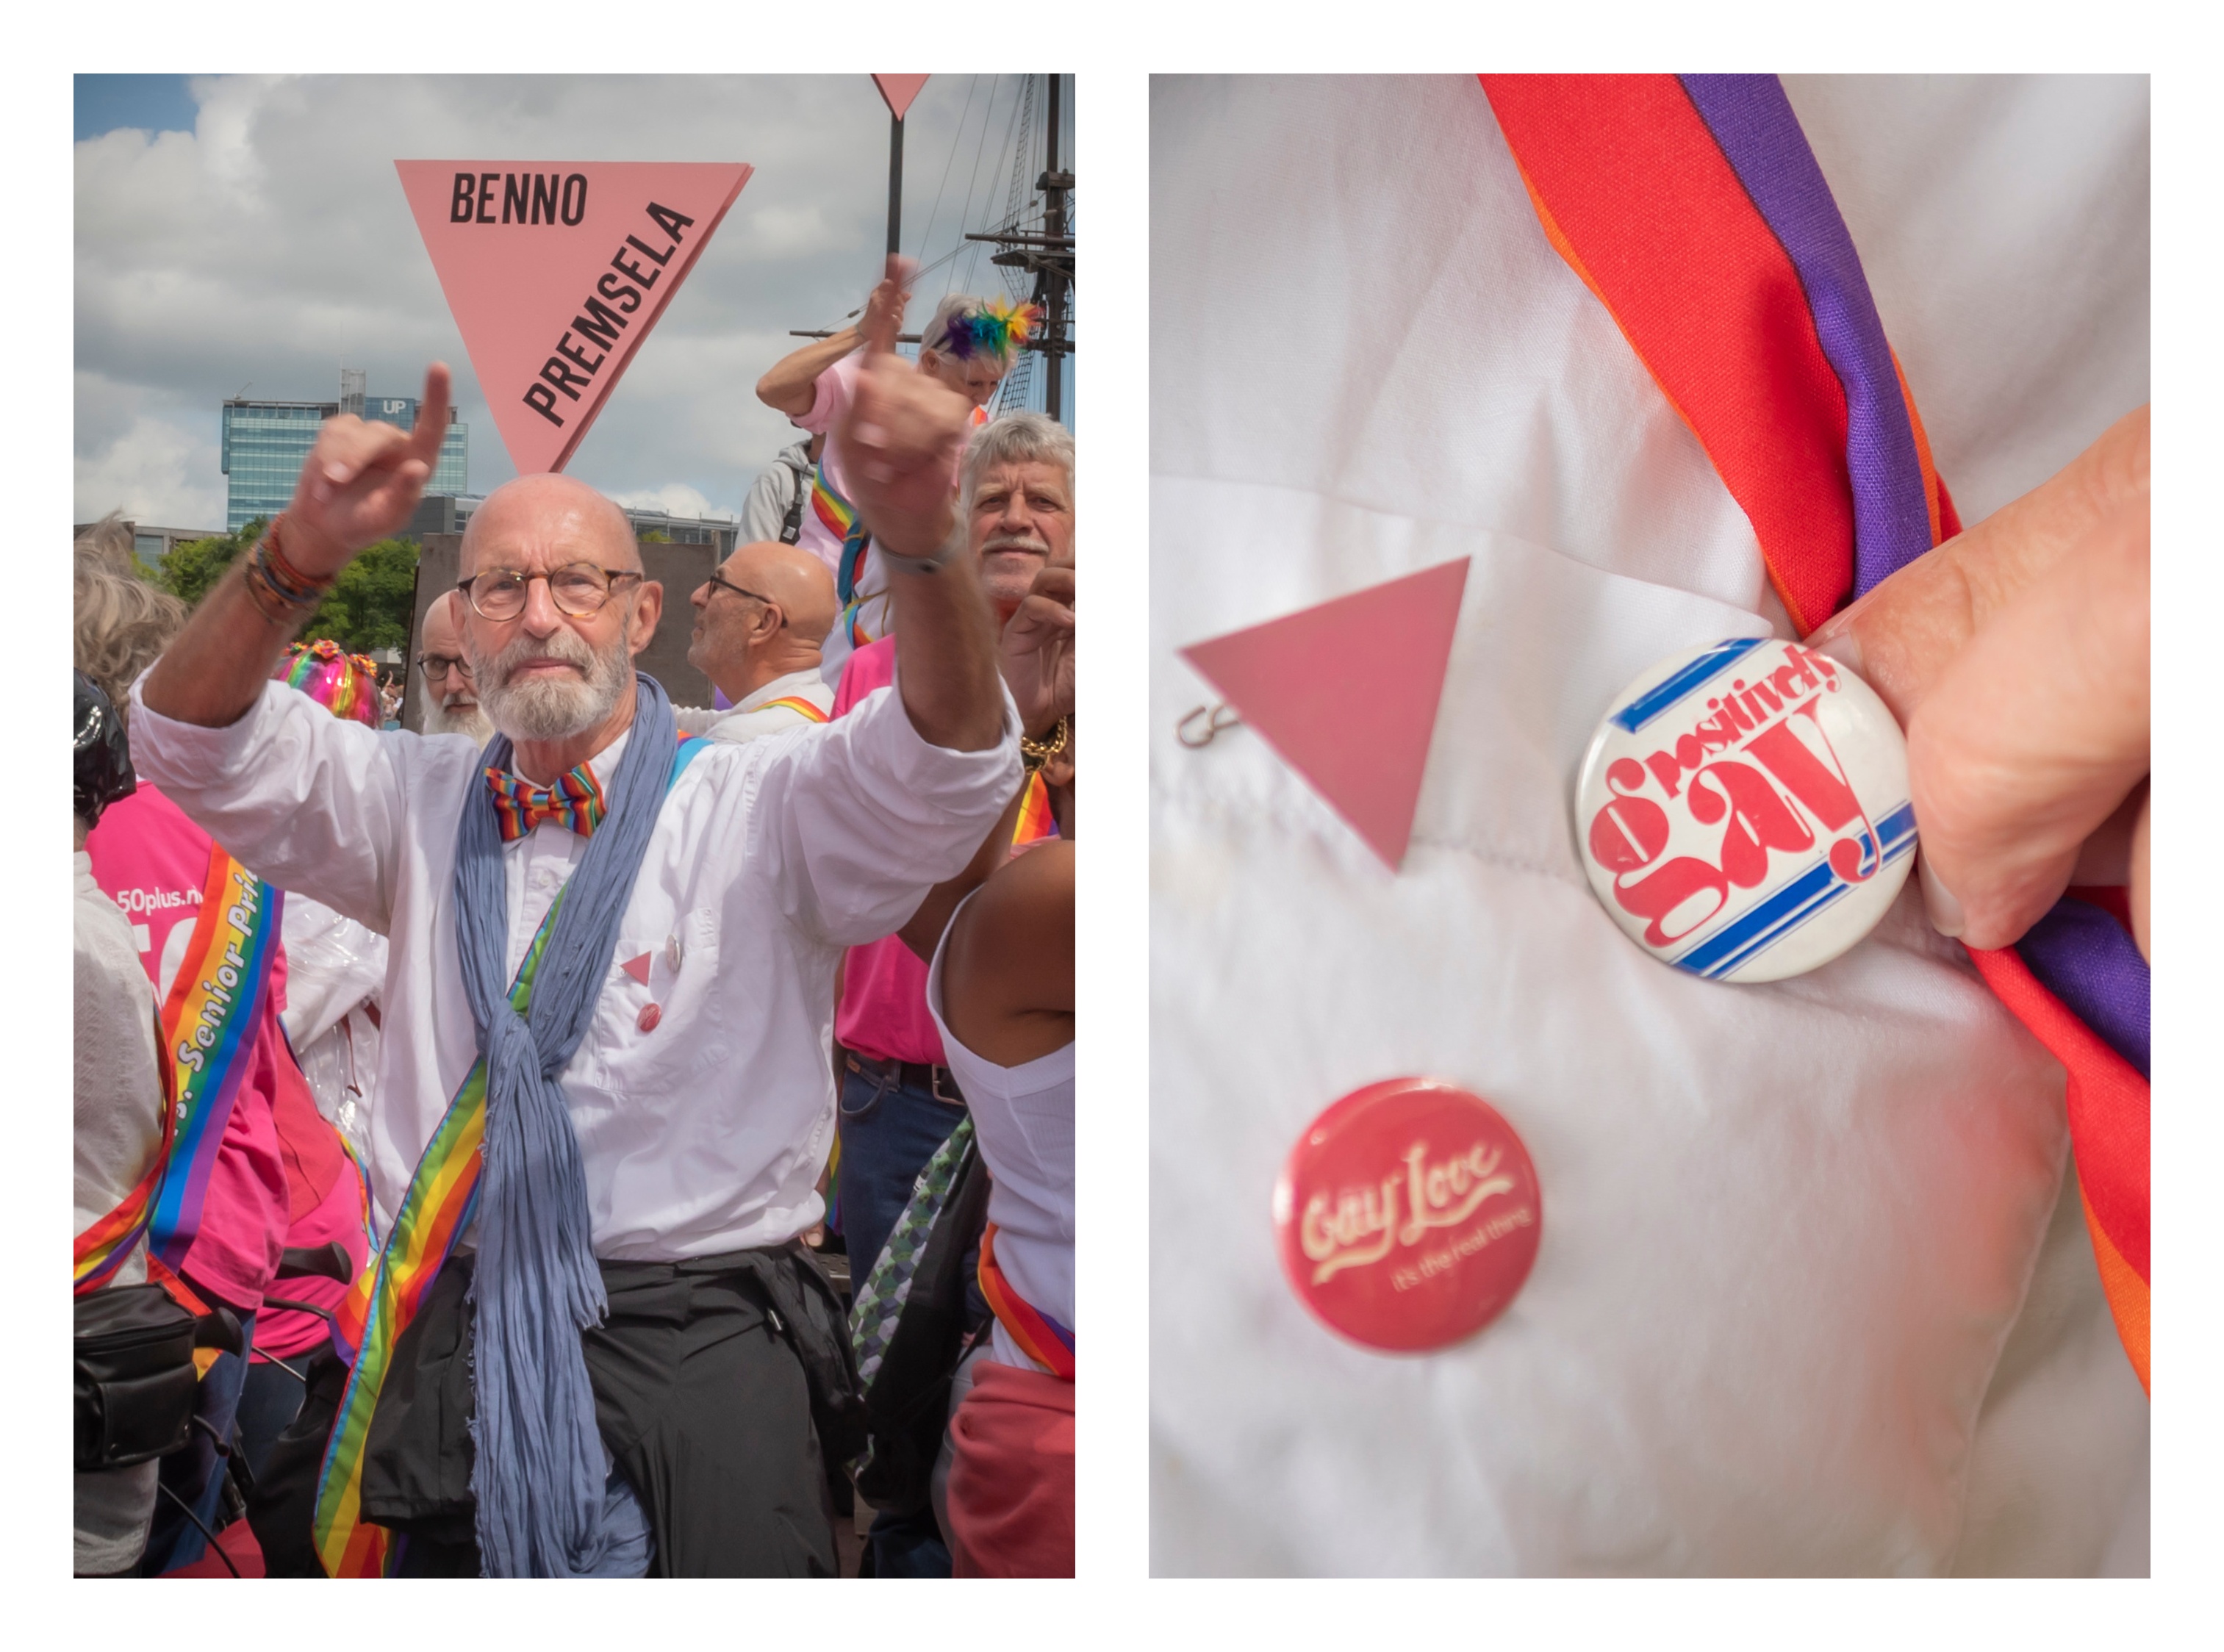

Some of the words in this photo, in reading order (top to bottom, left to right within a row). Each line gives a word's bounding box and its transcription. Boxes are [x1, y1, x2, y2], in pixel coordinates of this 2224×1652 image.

[450, 173, 588, 226] BENNO
[522, 201, 695, 428] PREMSELA
[383, 400, 406, 414] UP
[1643, 644, 1842, 800] positively
[1588, 693, 1881, 948] gay
[176, 941, 245, 1073] Senior
[1300, 1168, 1404, 1286] Gay
[1399, 1141, 1515, 1247] Love
[1418, 1251, 1452, 1278] the
[1449, 1227, 1488, 1262] real
